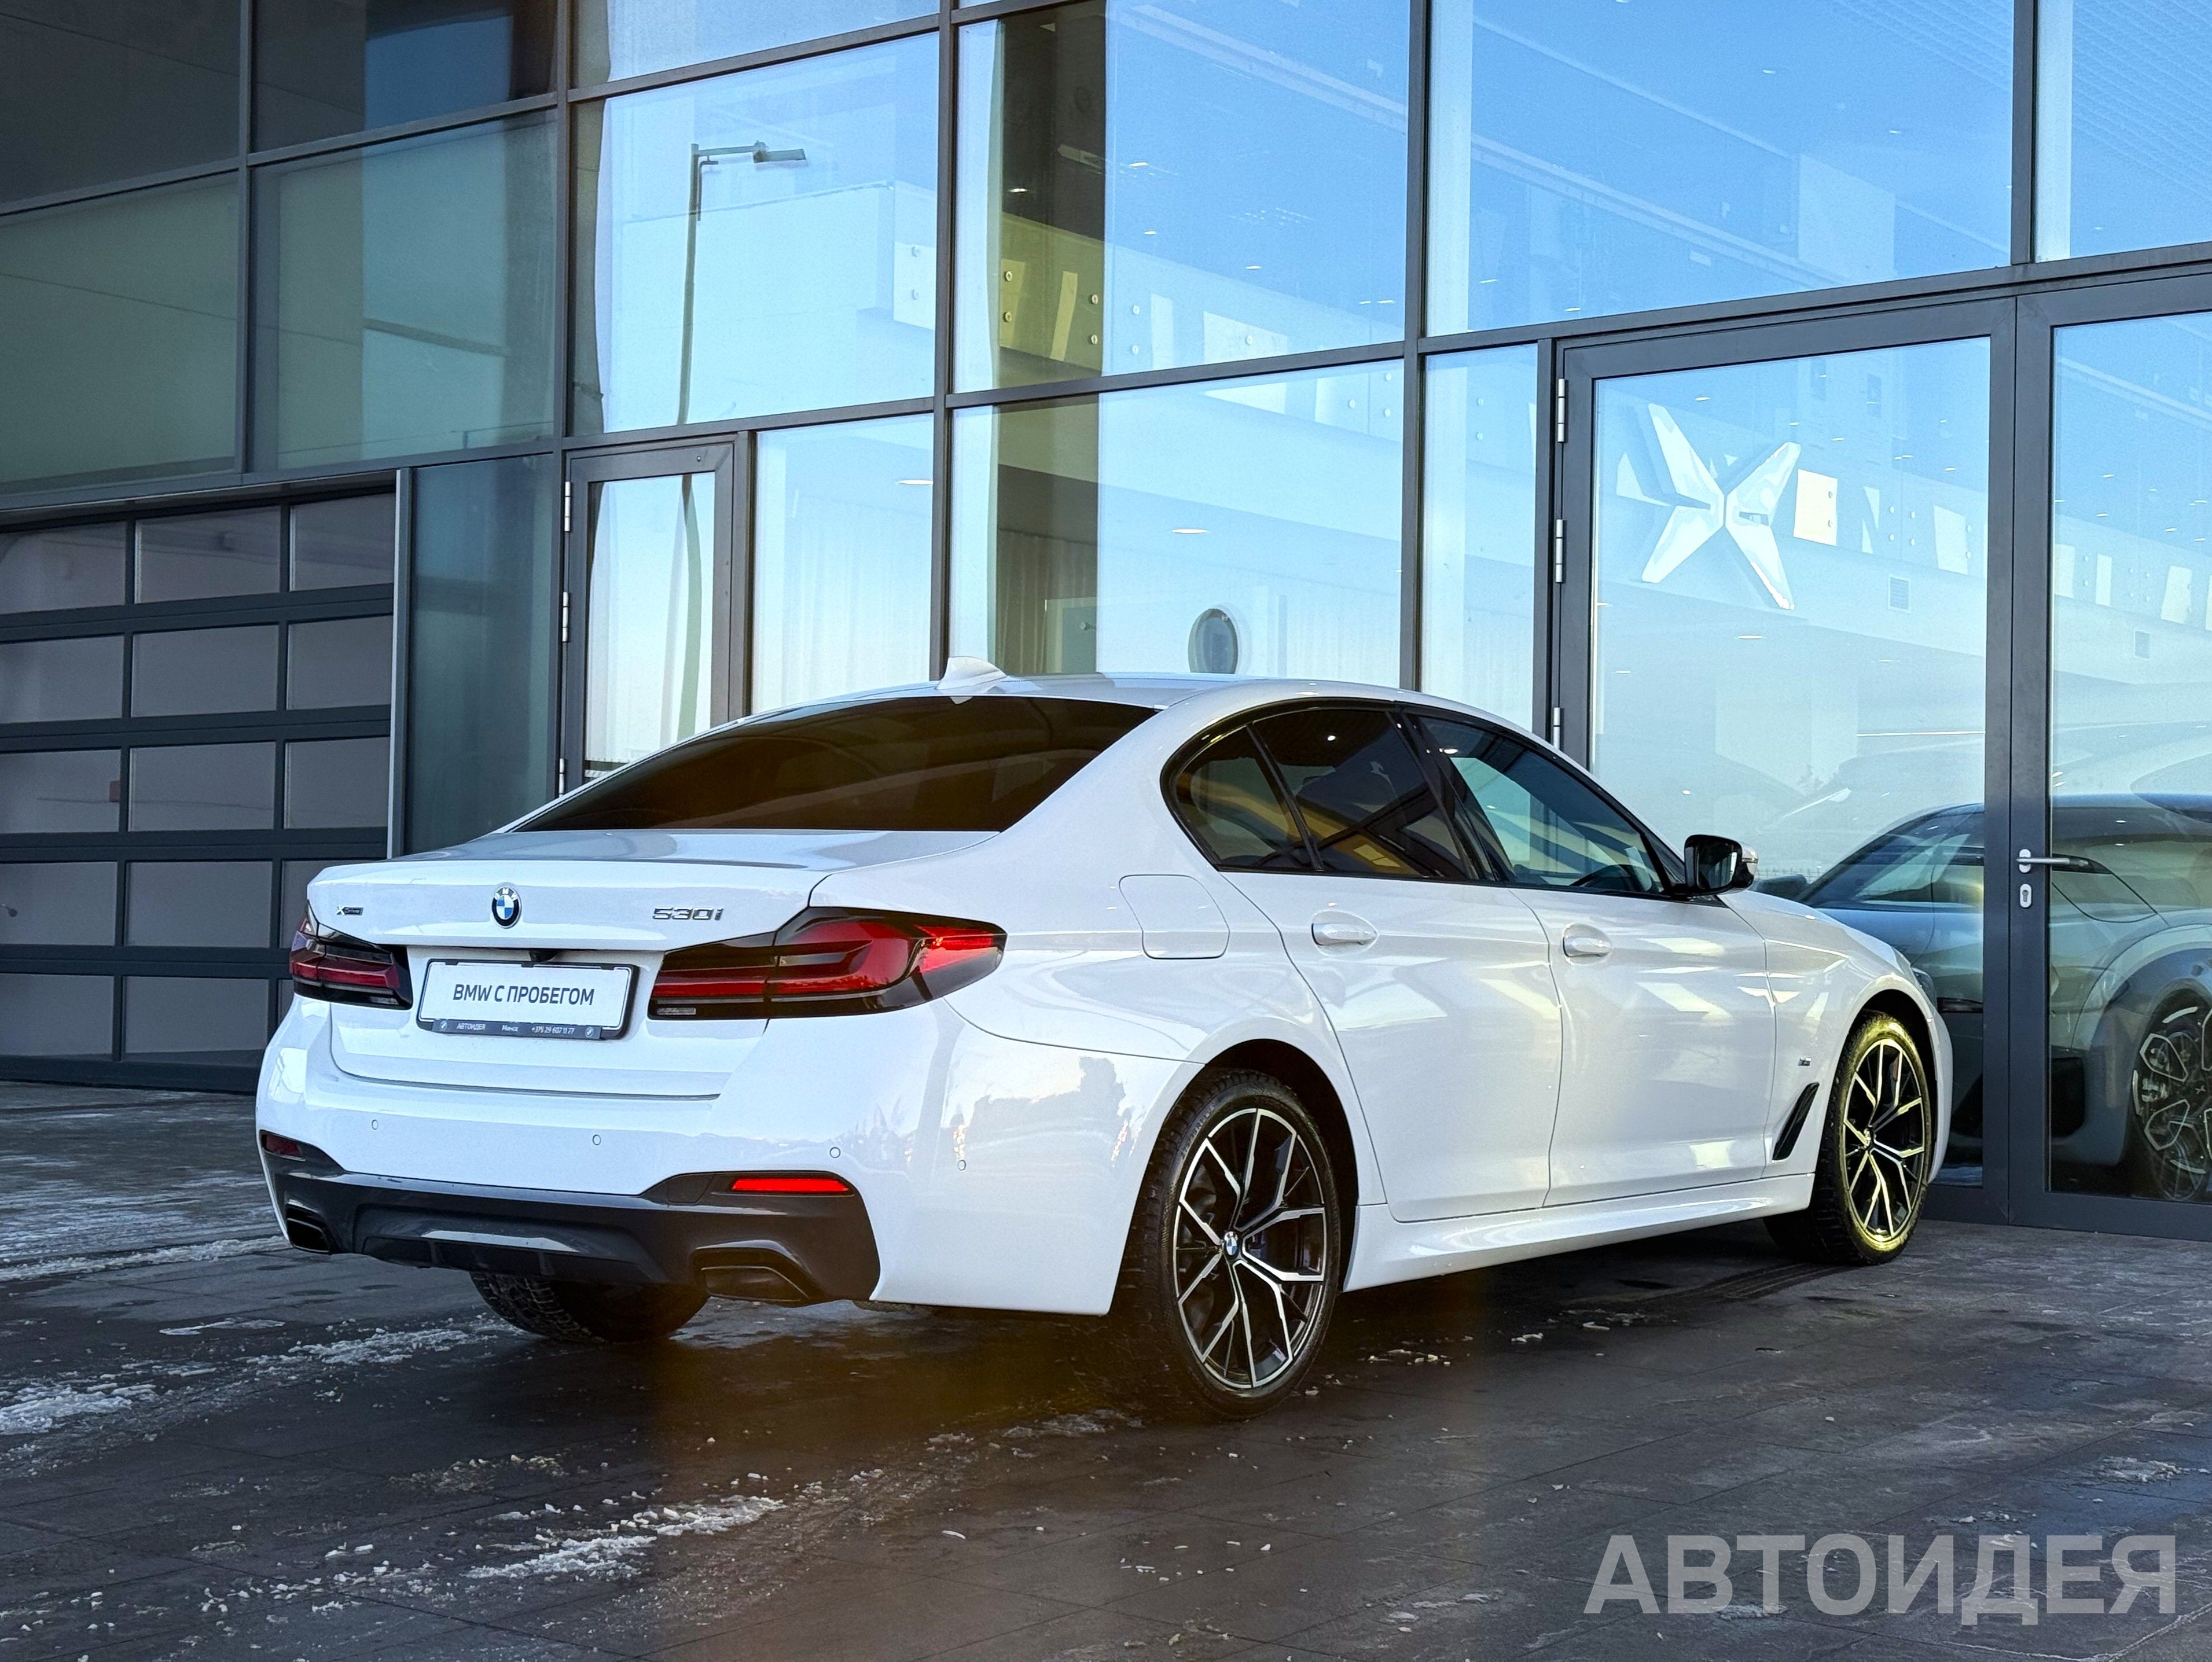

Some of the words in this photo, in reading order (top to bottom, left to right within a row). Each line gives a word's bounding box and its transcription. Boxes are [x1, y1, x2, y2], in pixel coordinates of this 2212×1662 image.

[652, 906, 723, 921] 530i
[453, 984, 493, 1002] BMW
[494, 985, 505, 1002] С
[506, 986, 595, 1006] ПРОБЕГОМ
